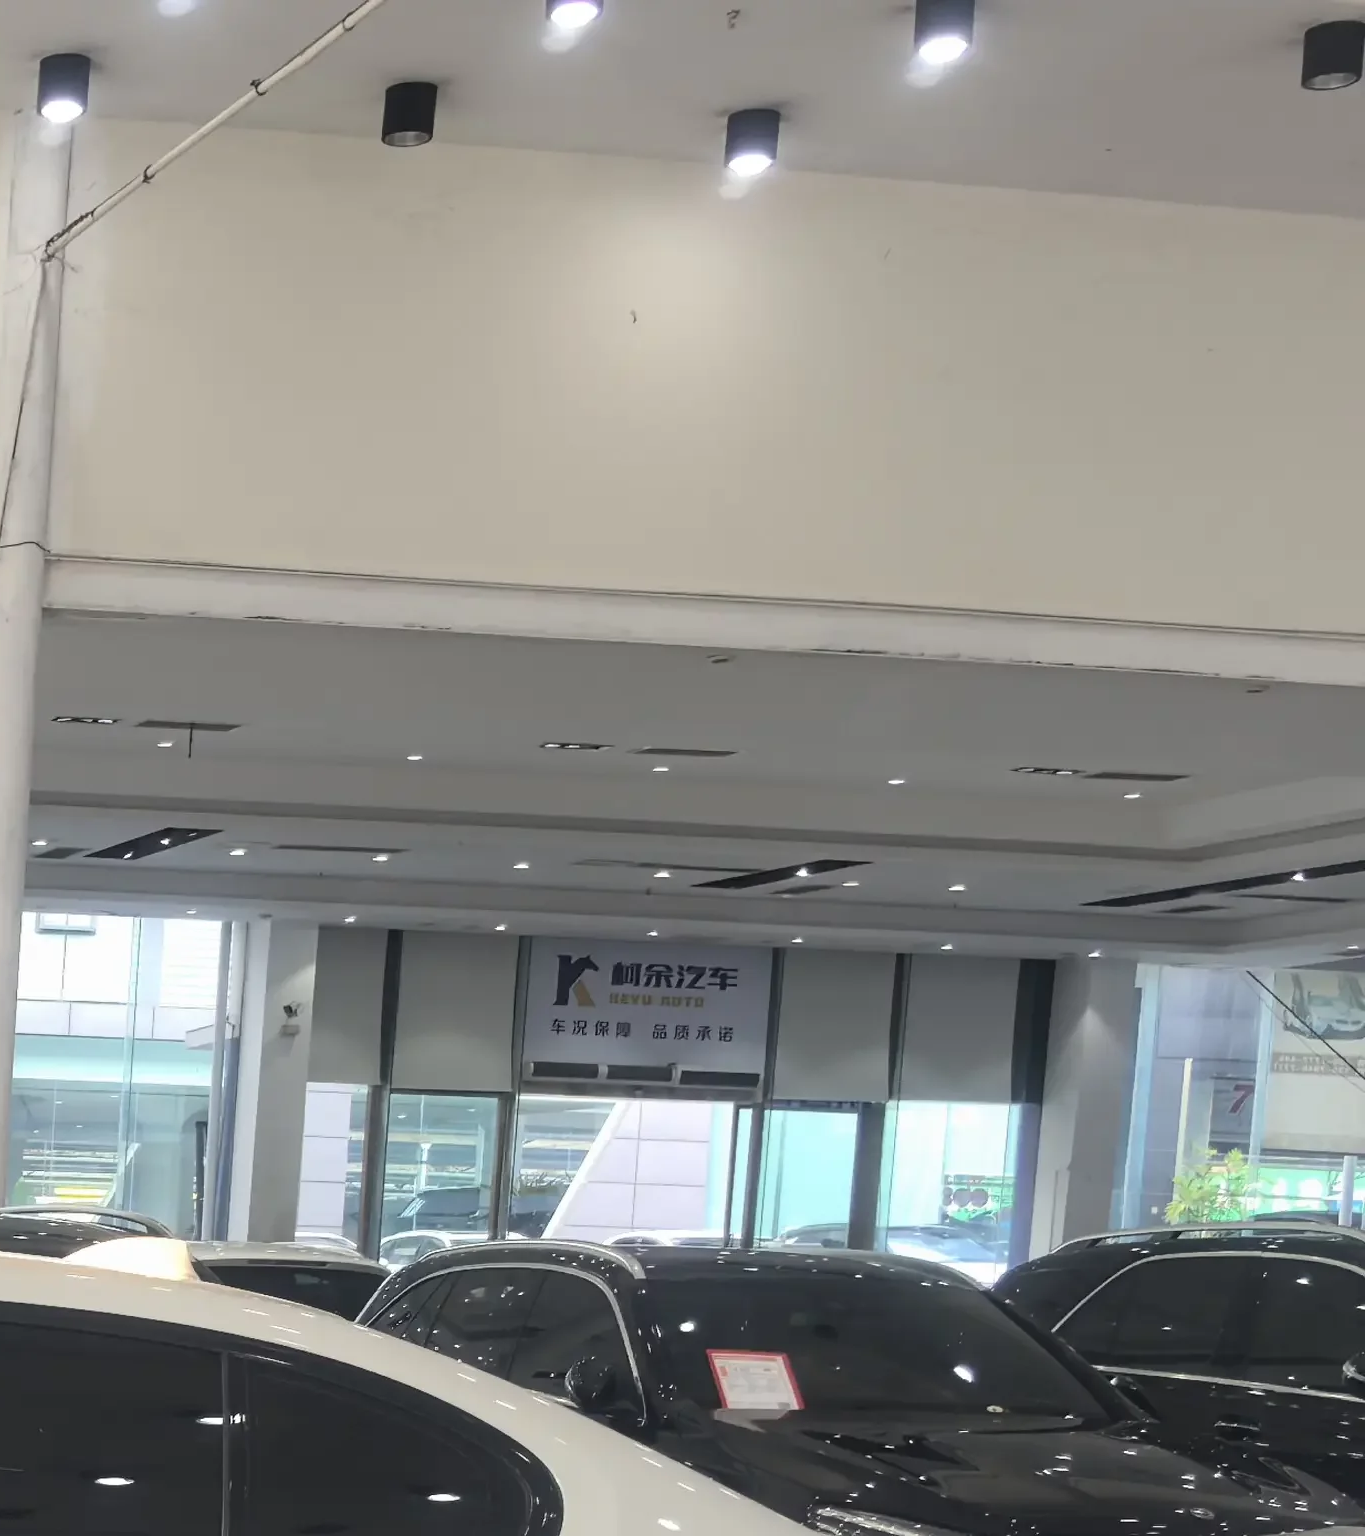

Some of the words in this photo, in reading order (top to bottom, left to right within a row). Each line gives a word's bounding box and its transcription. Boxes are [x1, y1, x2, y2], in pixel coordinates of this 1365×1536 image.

[550, 1018, 632, 1039] 车况保障
[652, 1023, 734, 1042] 品质承诺
